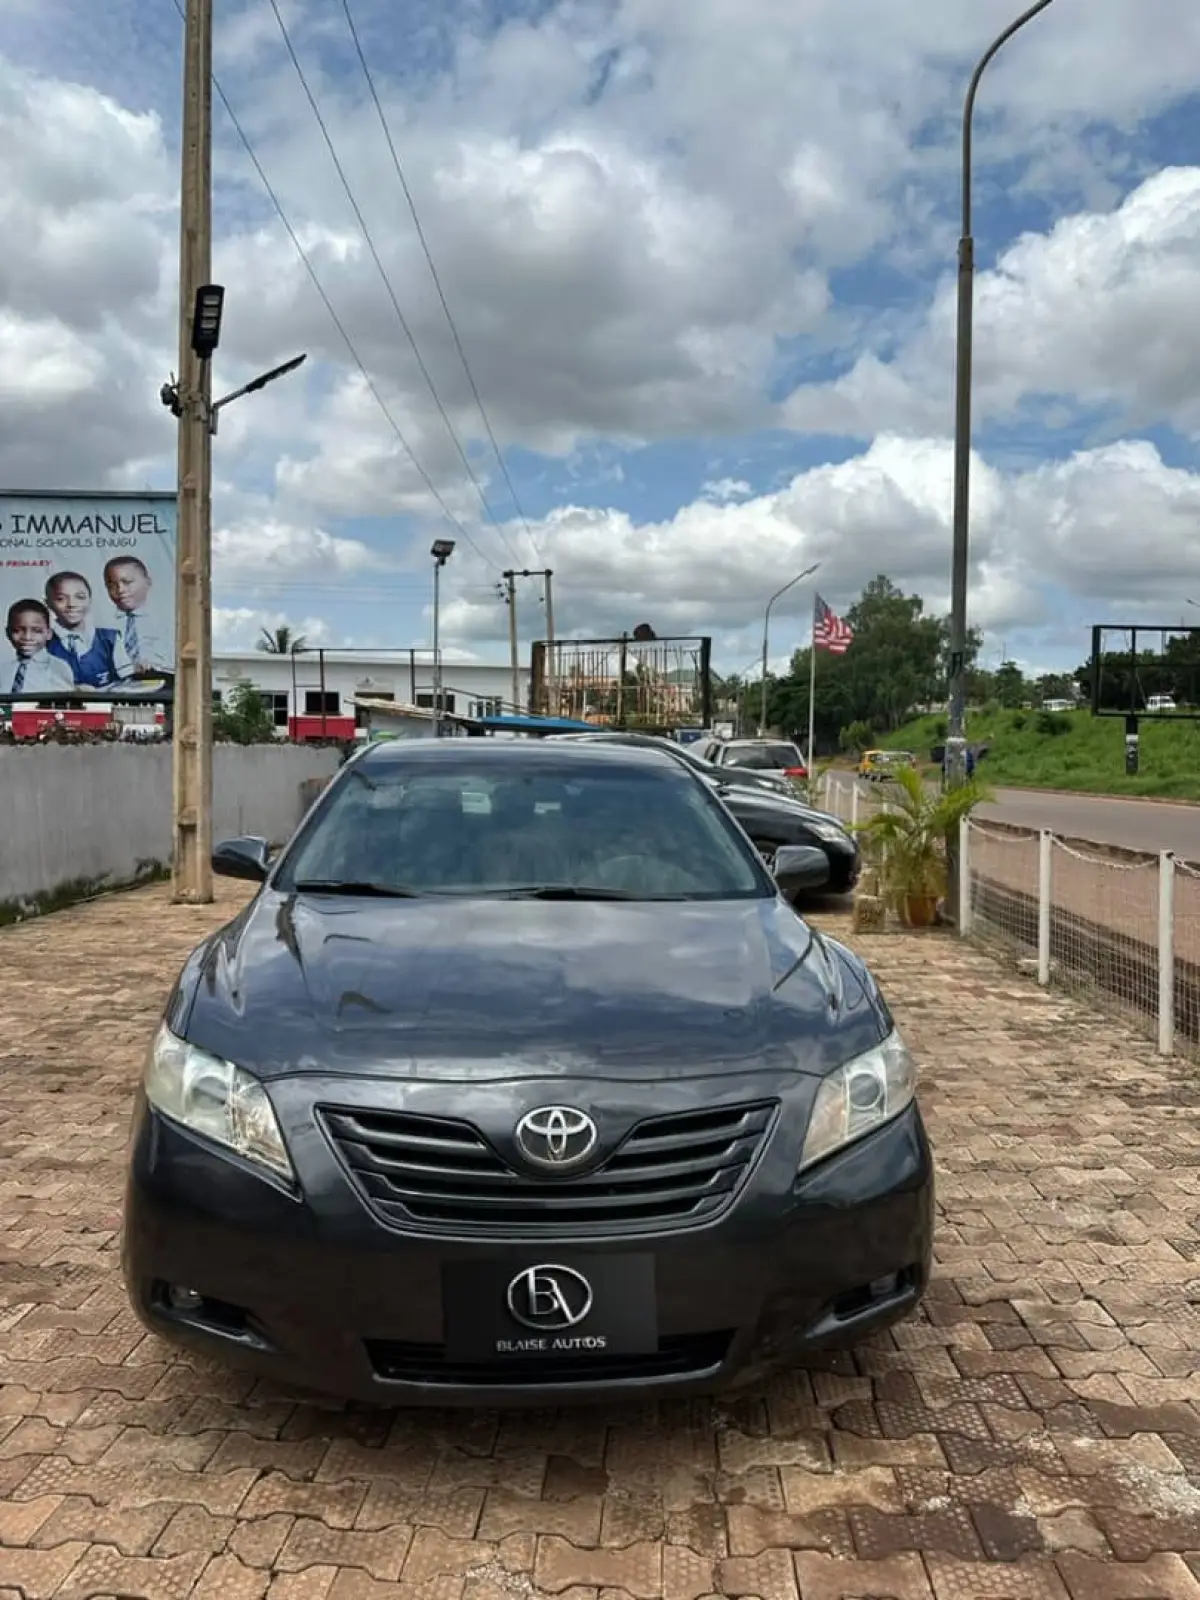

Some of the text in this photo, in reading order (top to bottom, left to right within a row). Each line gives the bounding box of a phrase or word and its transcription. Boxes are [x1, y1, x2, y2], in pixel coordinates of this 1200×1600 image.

[11, 513, 167, 534] IMMANUEL
[36, 538, 93, 548] SCHOOLS
[96, 537, 137, 548] ENUGU
[496, 1339, 547, 1352] BLAISE
